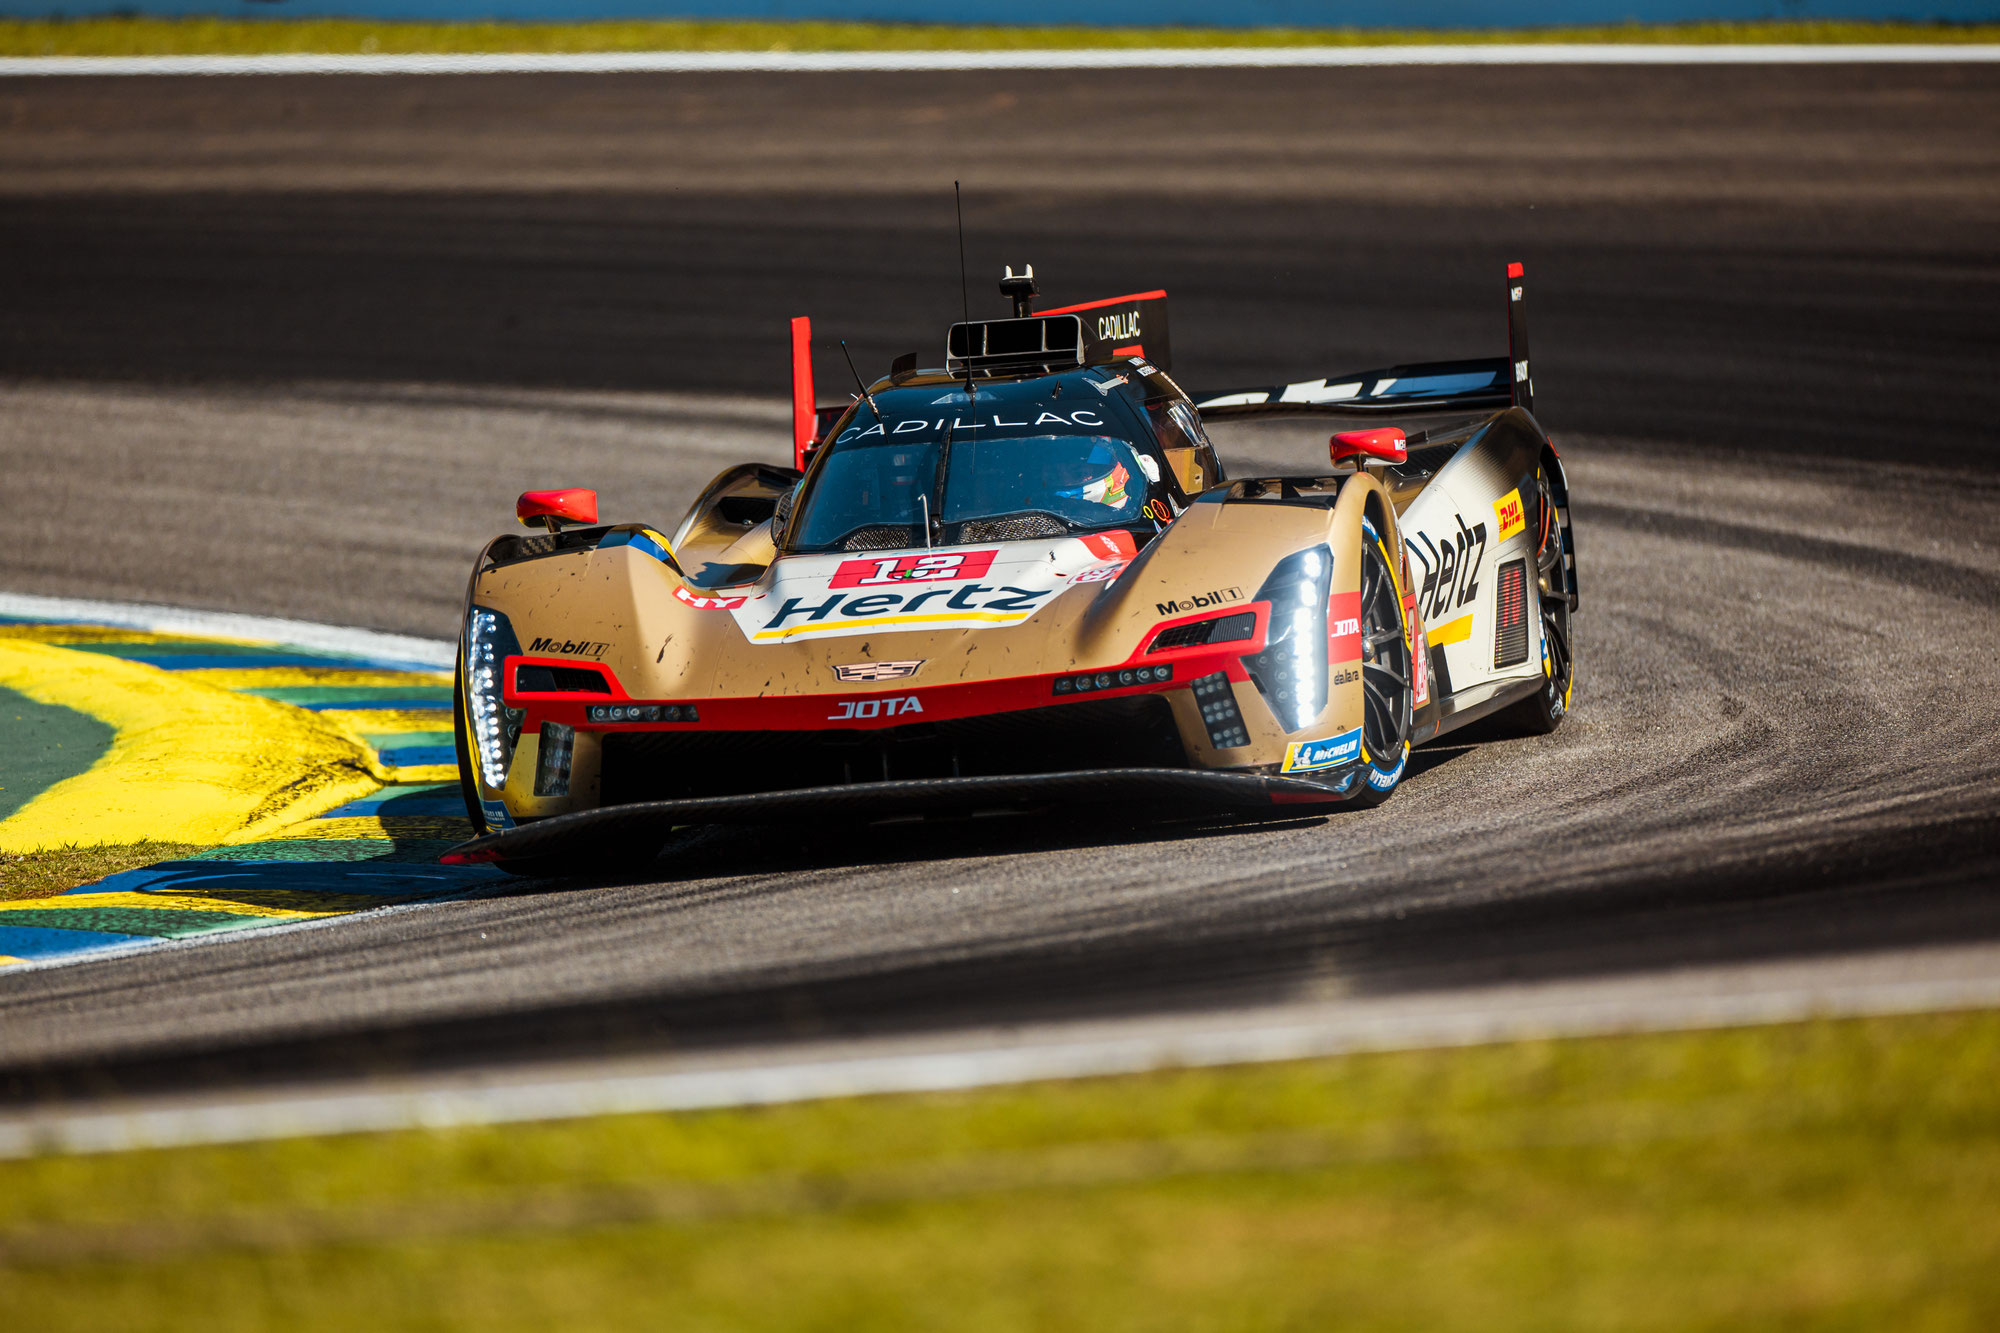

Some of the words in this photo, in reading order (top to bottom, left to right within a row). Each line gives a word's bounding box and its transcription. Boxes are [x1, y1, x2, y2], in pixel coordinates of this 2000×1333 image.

[1098, 311, 1141, 341] CADILLAC
[836, 410, 1104, 445] CADILLAC
[859, 555, 967, 585] 12
[1405, 514, 1487, 622] Hertz
[763, 583, 1053, 630] Hertz
[1156, 591, 1222, 615] Mobil
[1331, 618, 1360, 638] JOTA
[528, 637, 590, 655] Mobil
[828, 696, 924, 721] JOTA
[1312, 739, 1358, 762] MICHELIN
